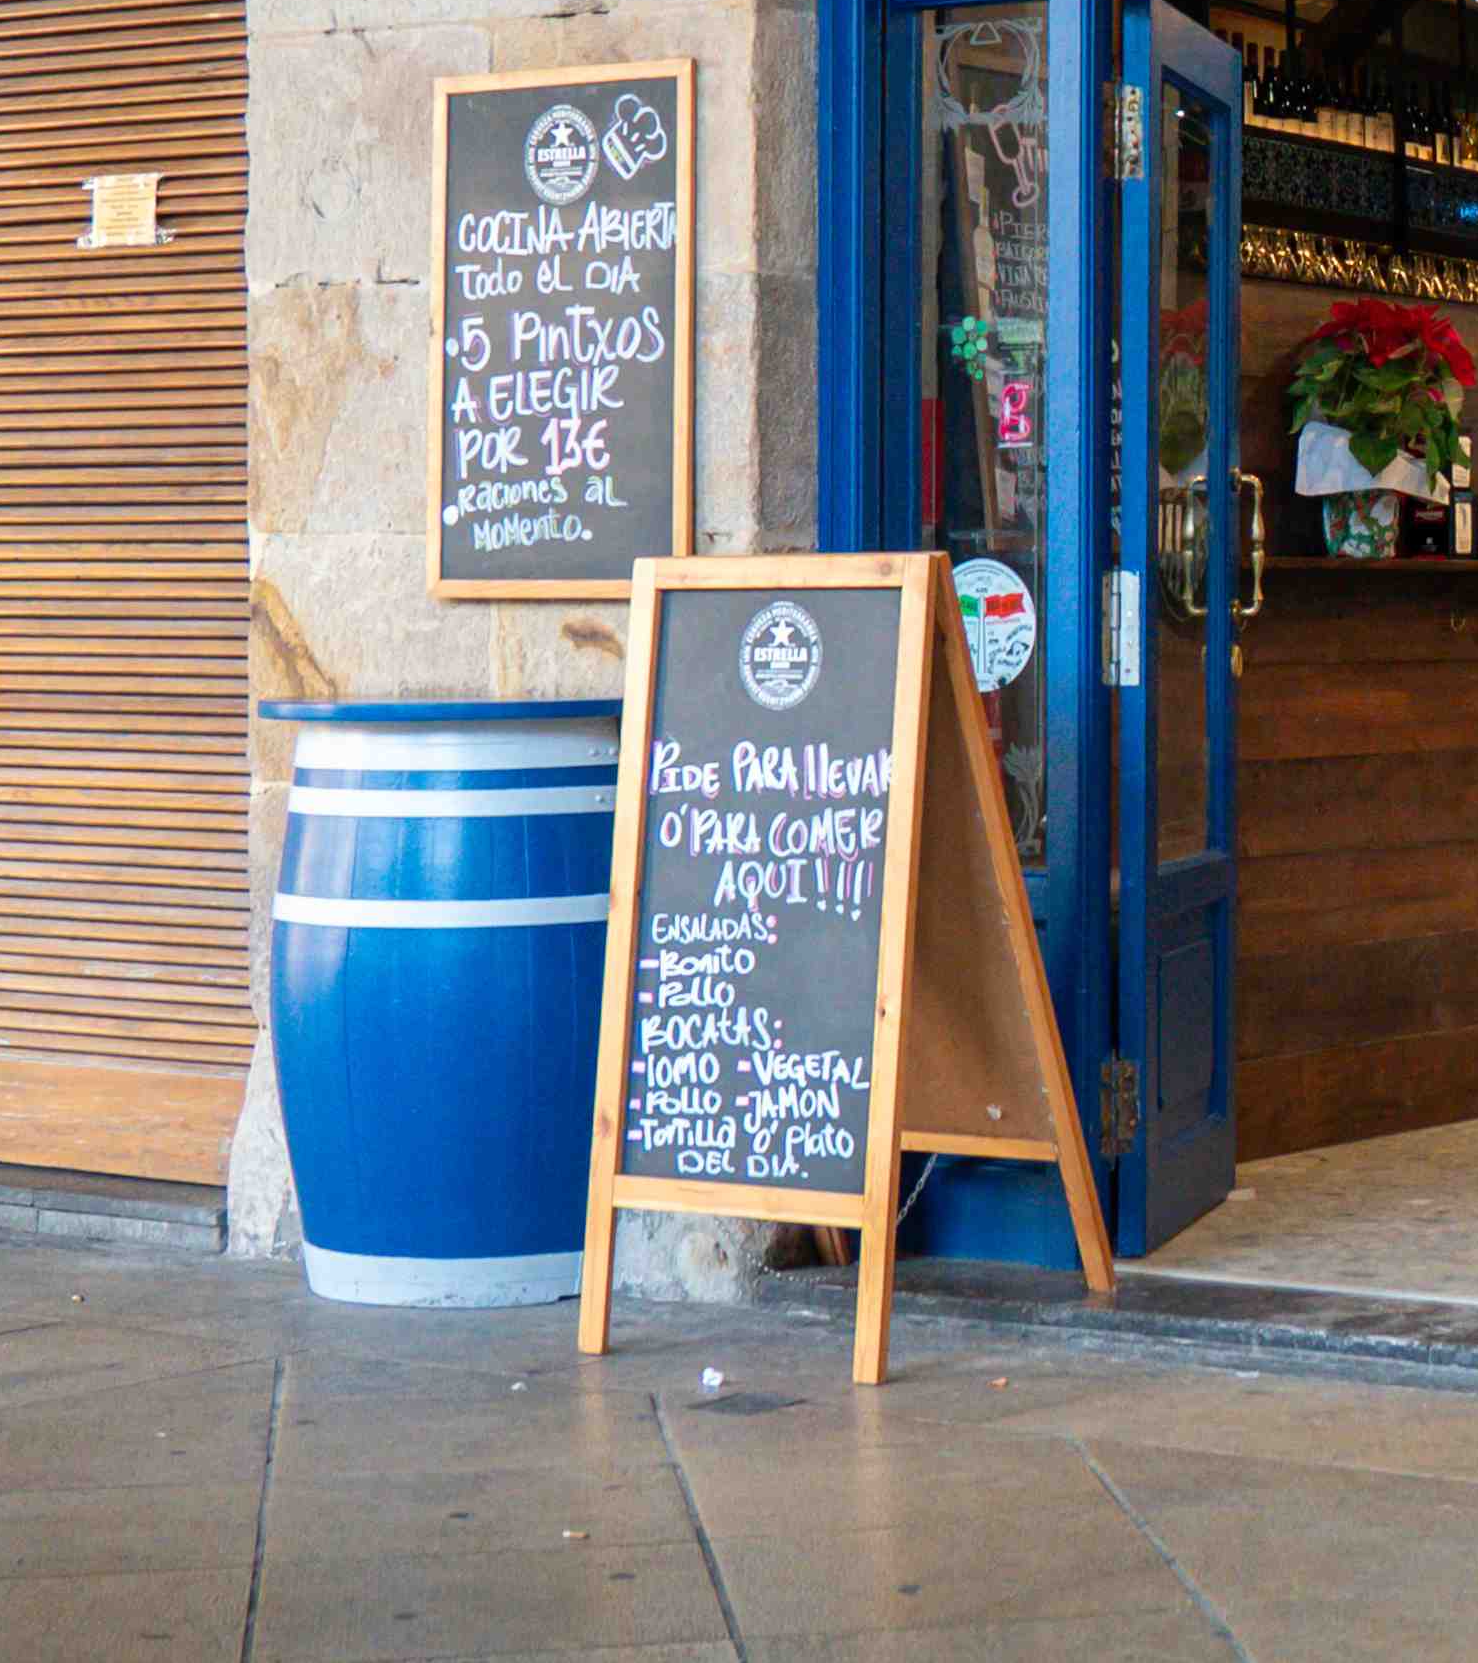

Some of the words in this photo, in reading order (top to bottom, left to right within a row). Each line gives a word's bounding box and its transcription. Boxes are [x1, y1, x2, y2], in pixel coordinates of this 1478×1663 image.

[538, 146, 587, 162] ESTRELLA
[458, 205, 575, 255] COCINA
[585, 255, 641, 295] DIA
[460, 317, 491, 371] 5
[452, 377, 479, 423] A
[489, 365, 623, 422] ELEGIR
[458, 427, 528, 479] POR
[541, 418, 610, 475] 13€
[754, 647, 808, 662] ESTRELLA
[652, 741, 720, 794] PIDE
[733, 741, 797, 793] PARA
[692, 808, 761, 853] PARA
[769, 807, 883, 857] COMER
[652, 912, 777, 945] ENSALADAS:
[678, 1151, 735, 1174] DEL
